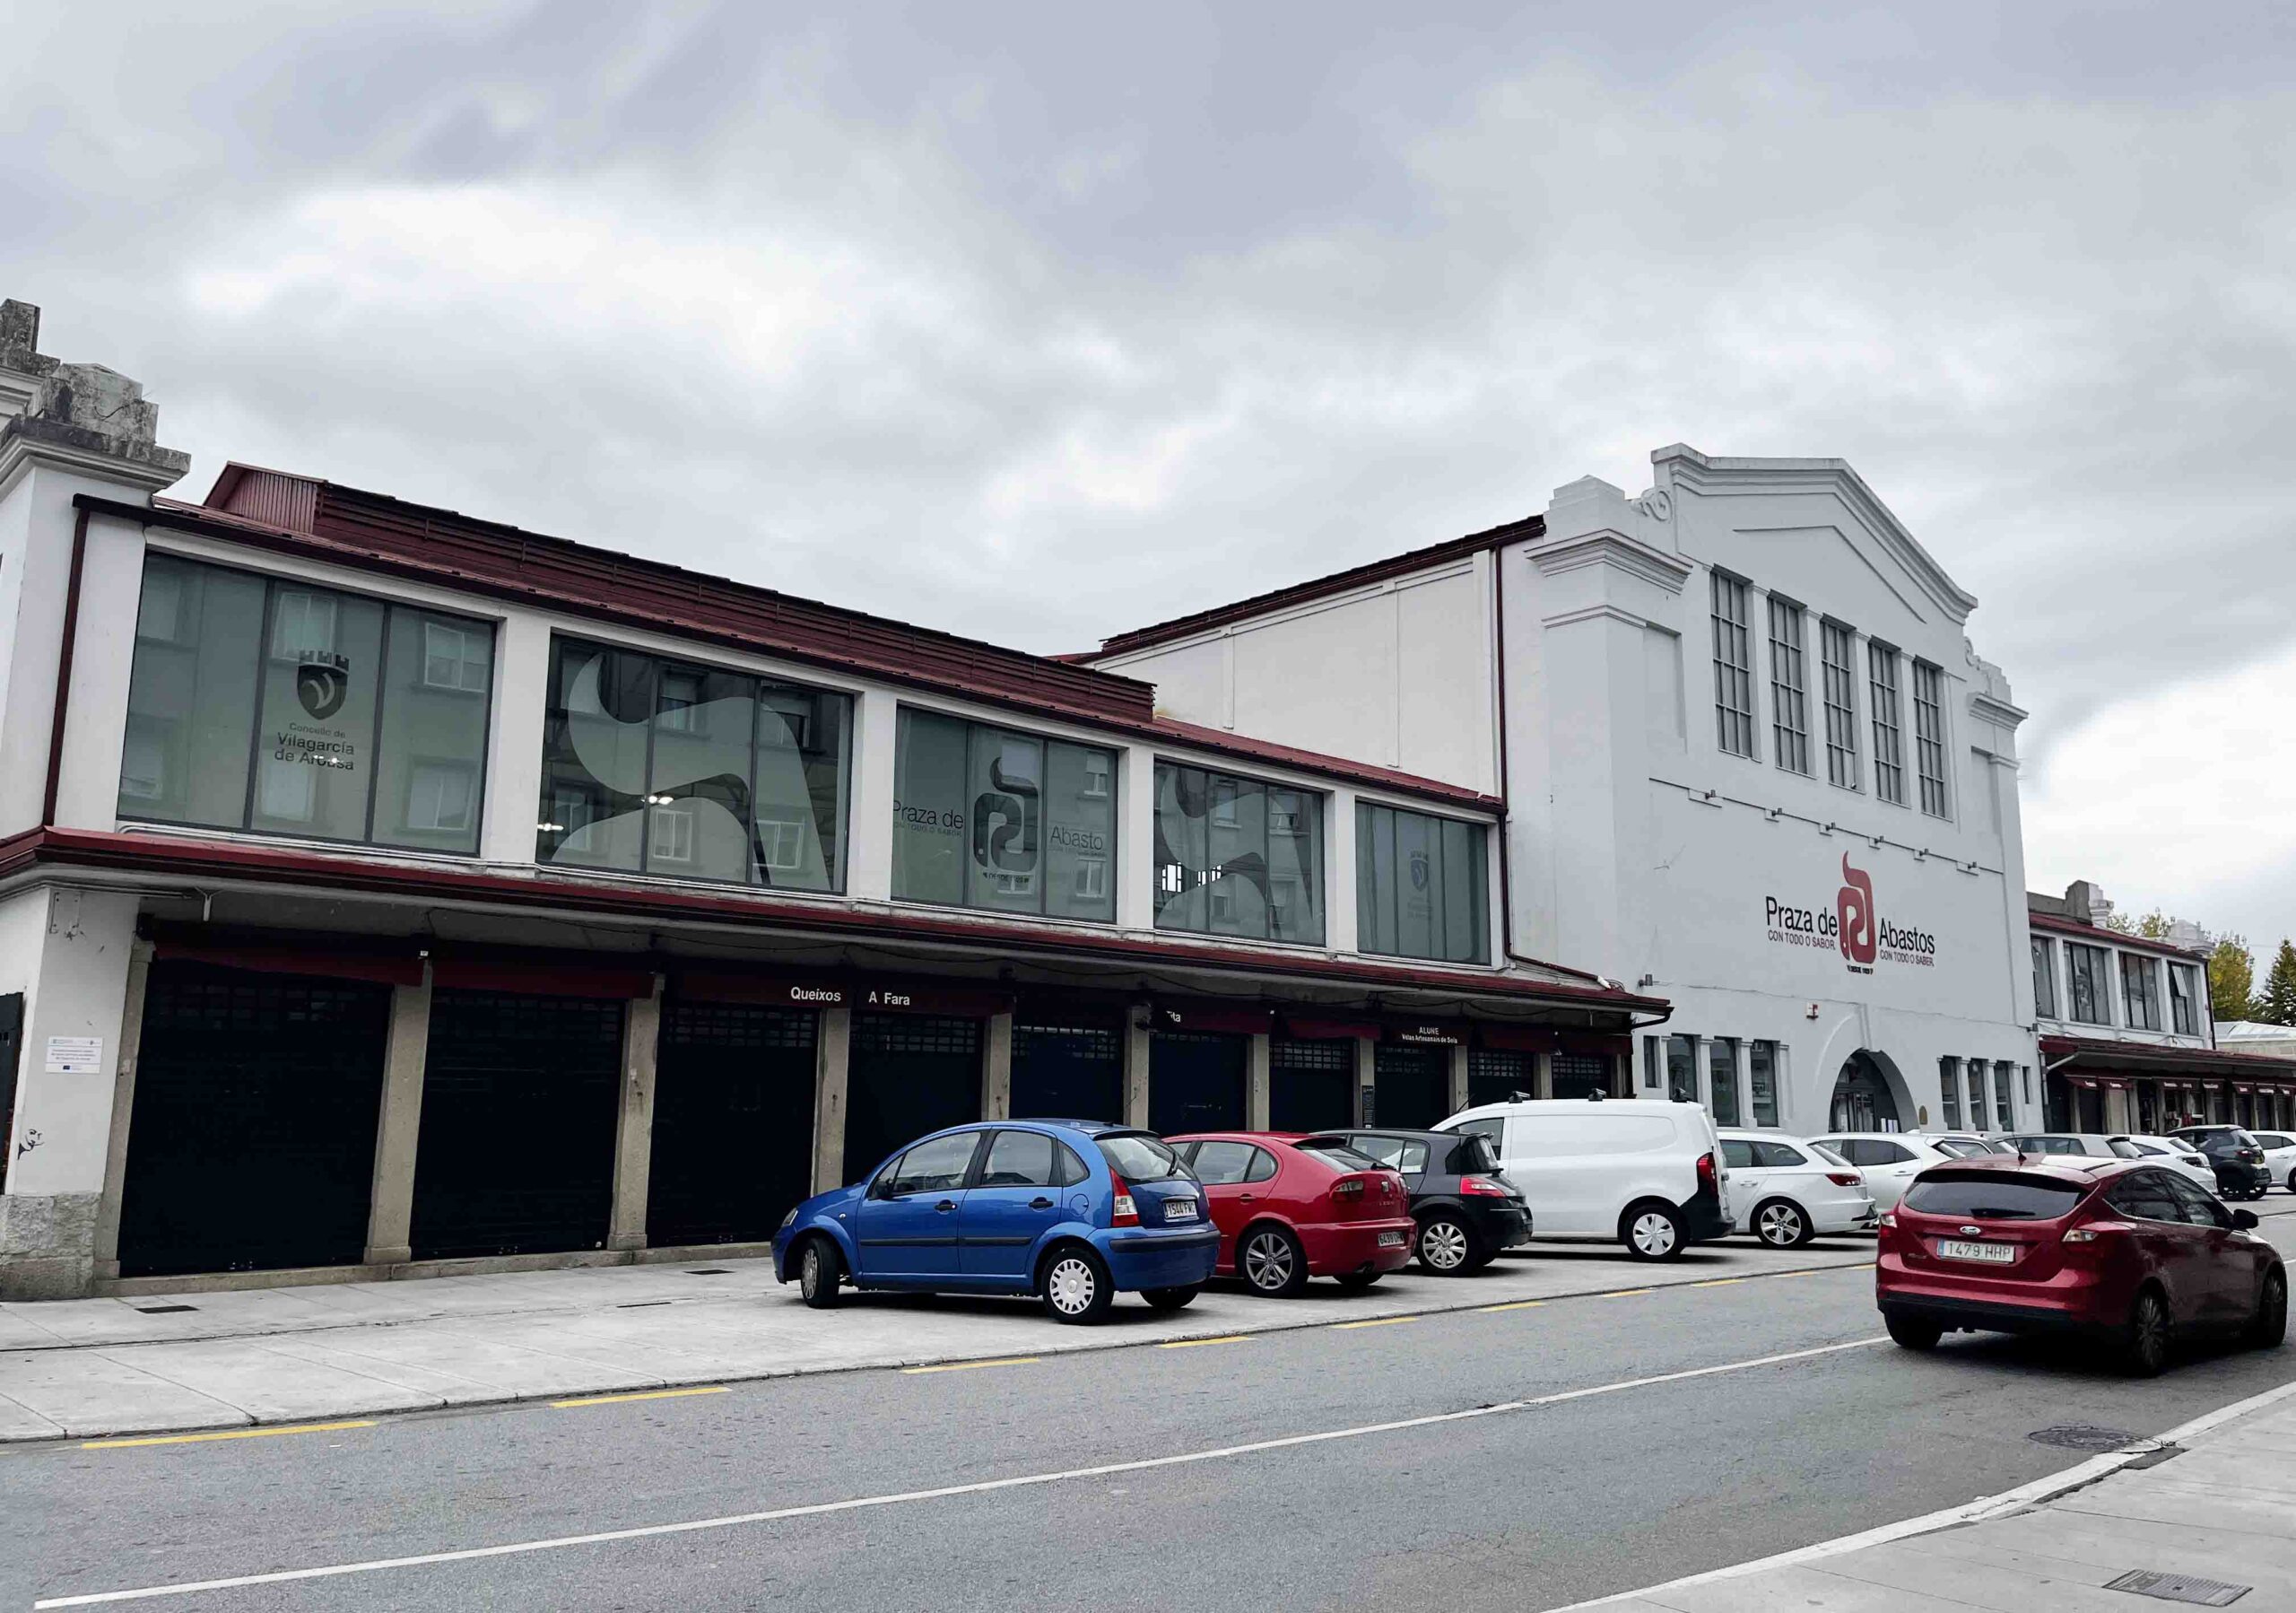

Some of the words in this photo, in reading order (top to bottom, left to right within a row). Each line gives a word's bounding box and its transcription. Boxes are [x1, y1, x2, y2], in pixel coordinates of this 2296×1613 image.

[277, 731, 354, 755] Vilagarcía
[274, 748, 295, 762] de
[942, 809, 964, 829] de
[1765, 896, 1813, 934] Praza
[1818, 907, 1838, 937] de
[1768, 929, 1784, 942] CON
[1785, 932, 1805, 946] TODO
[1805, 936, 1811, 946] O
[1879, 917, 1935, 955] Abastos
[1880, 949, 1892, 961] CON
[1893, 951, 1909, 963] TODO
[790, 986, 842, 1002] Queixos
[868, 991, 877, 1004] A
[884, 992, 910, 1006] Fara
[1419, 1026, 1439, 1035] ALUNE
[1948, 1242, 1980, 1257] 1479
[1985, 1245, 2010, 1260] HHP
